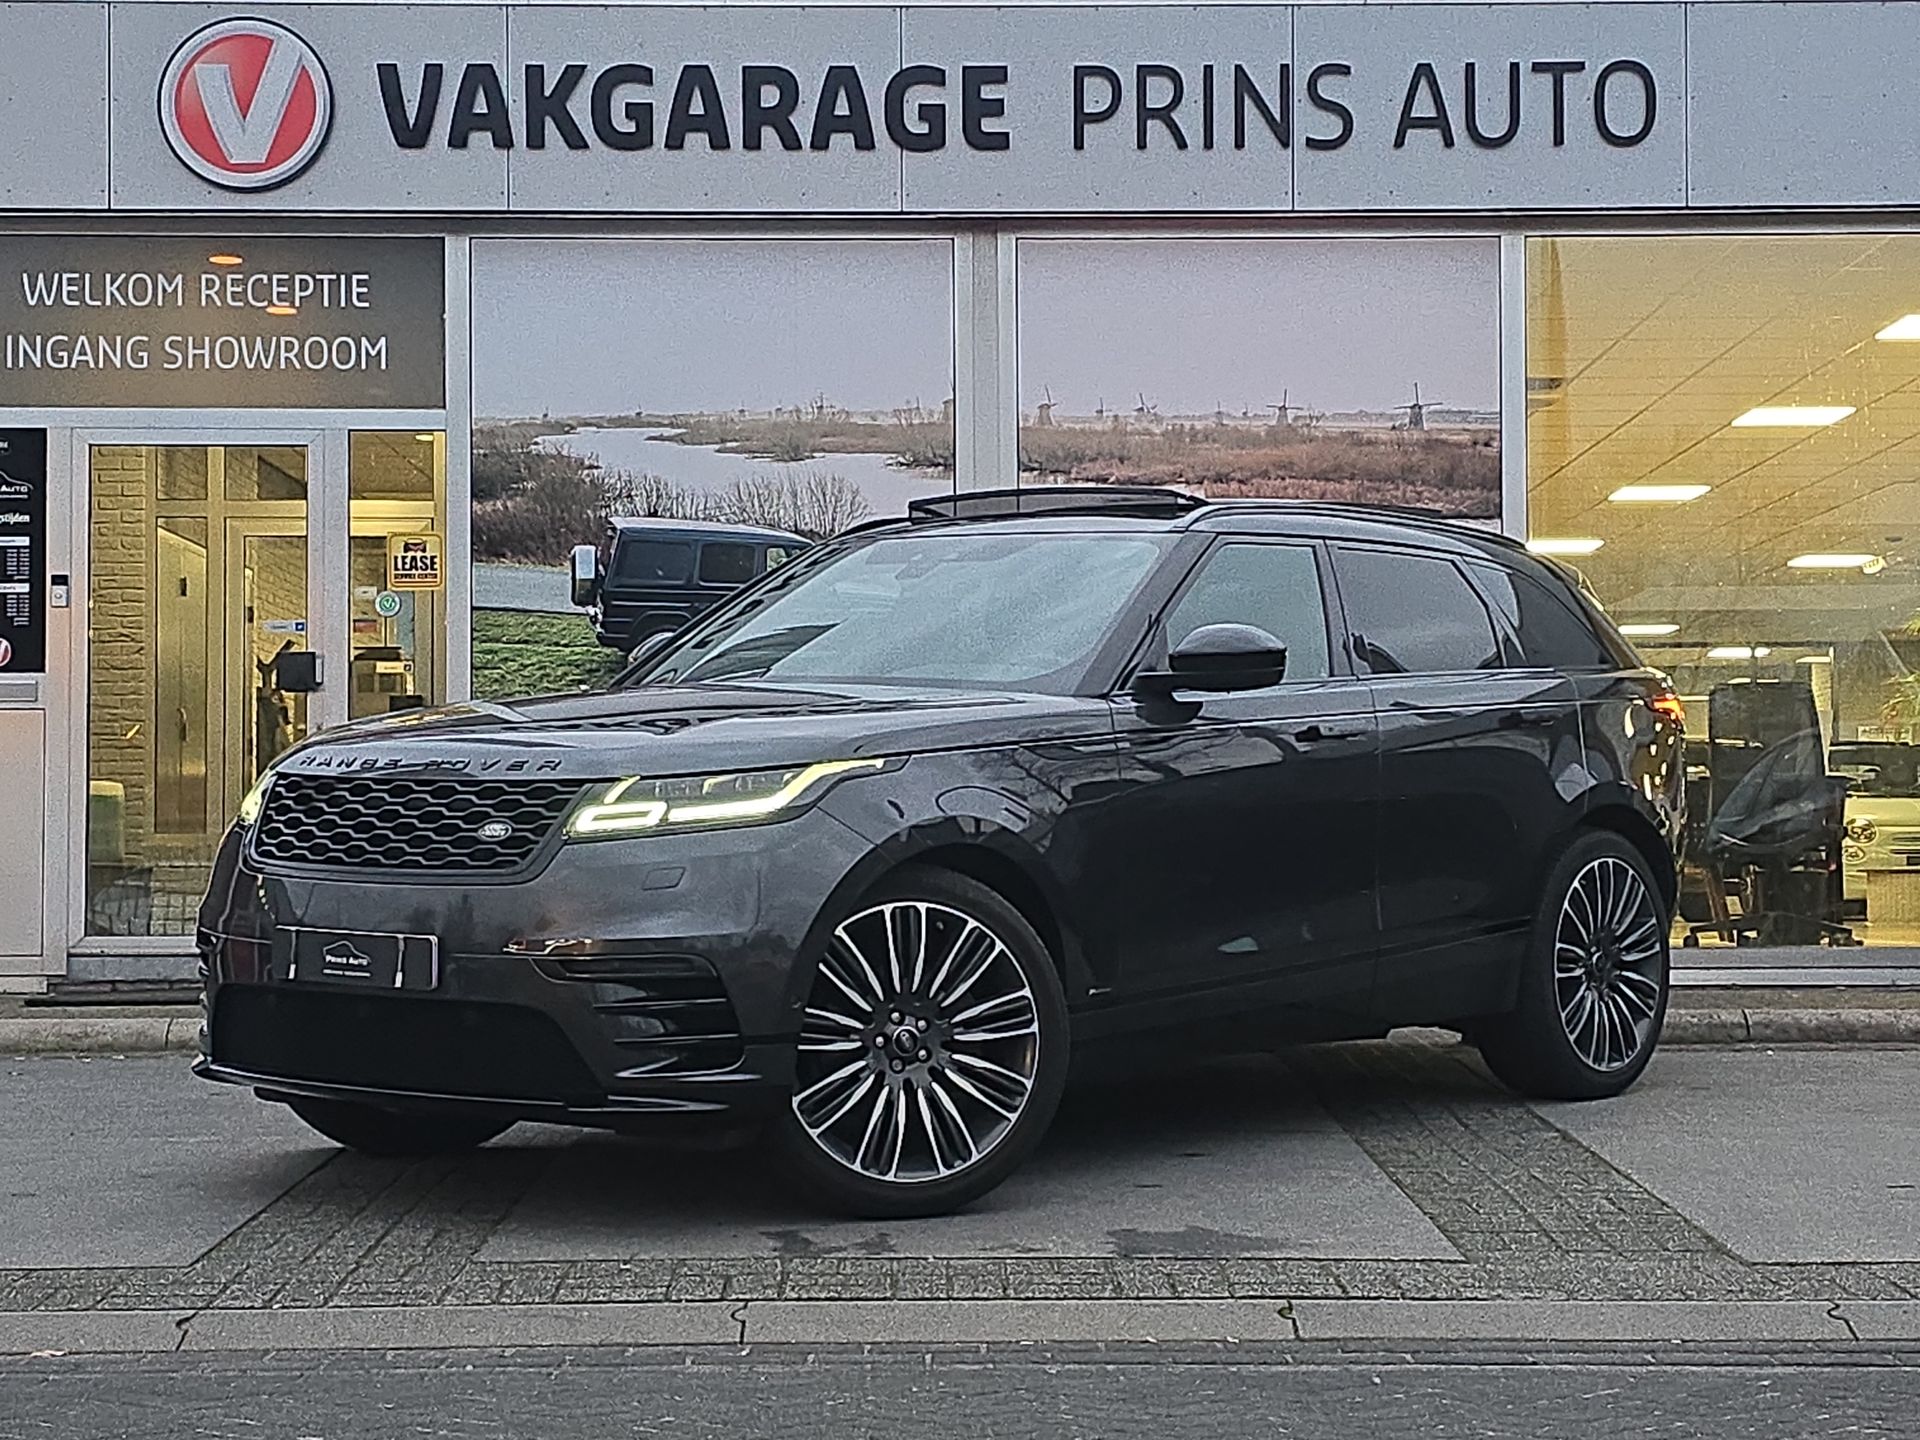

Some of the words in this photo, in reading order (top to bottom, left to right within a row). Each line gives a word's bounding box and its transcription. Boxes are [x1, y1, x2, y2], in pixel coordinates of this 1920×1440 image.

[376, 63, 1010, 152] VAKGARAGE
[1073, 63, 1354, 151] PRINS
[1393, 59, 1657, 150] AUTO
[22, 272, 183, 307] WELKOM
[201, 273, 370, 308] RECEPTIE
[5, 334, 149, 369] INGANG
[163, 335, 387, 370] SHOWROOM
[393, 554, 438, 572] LEASE
